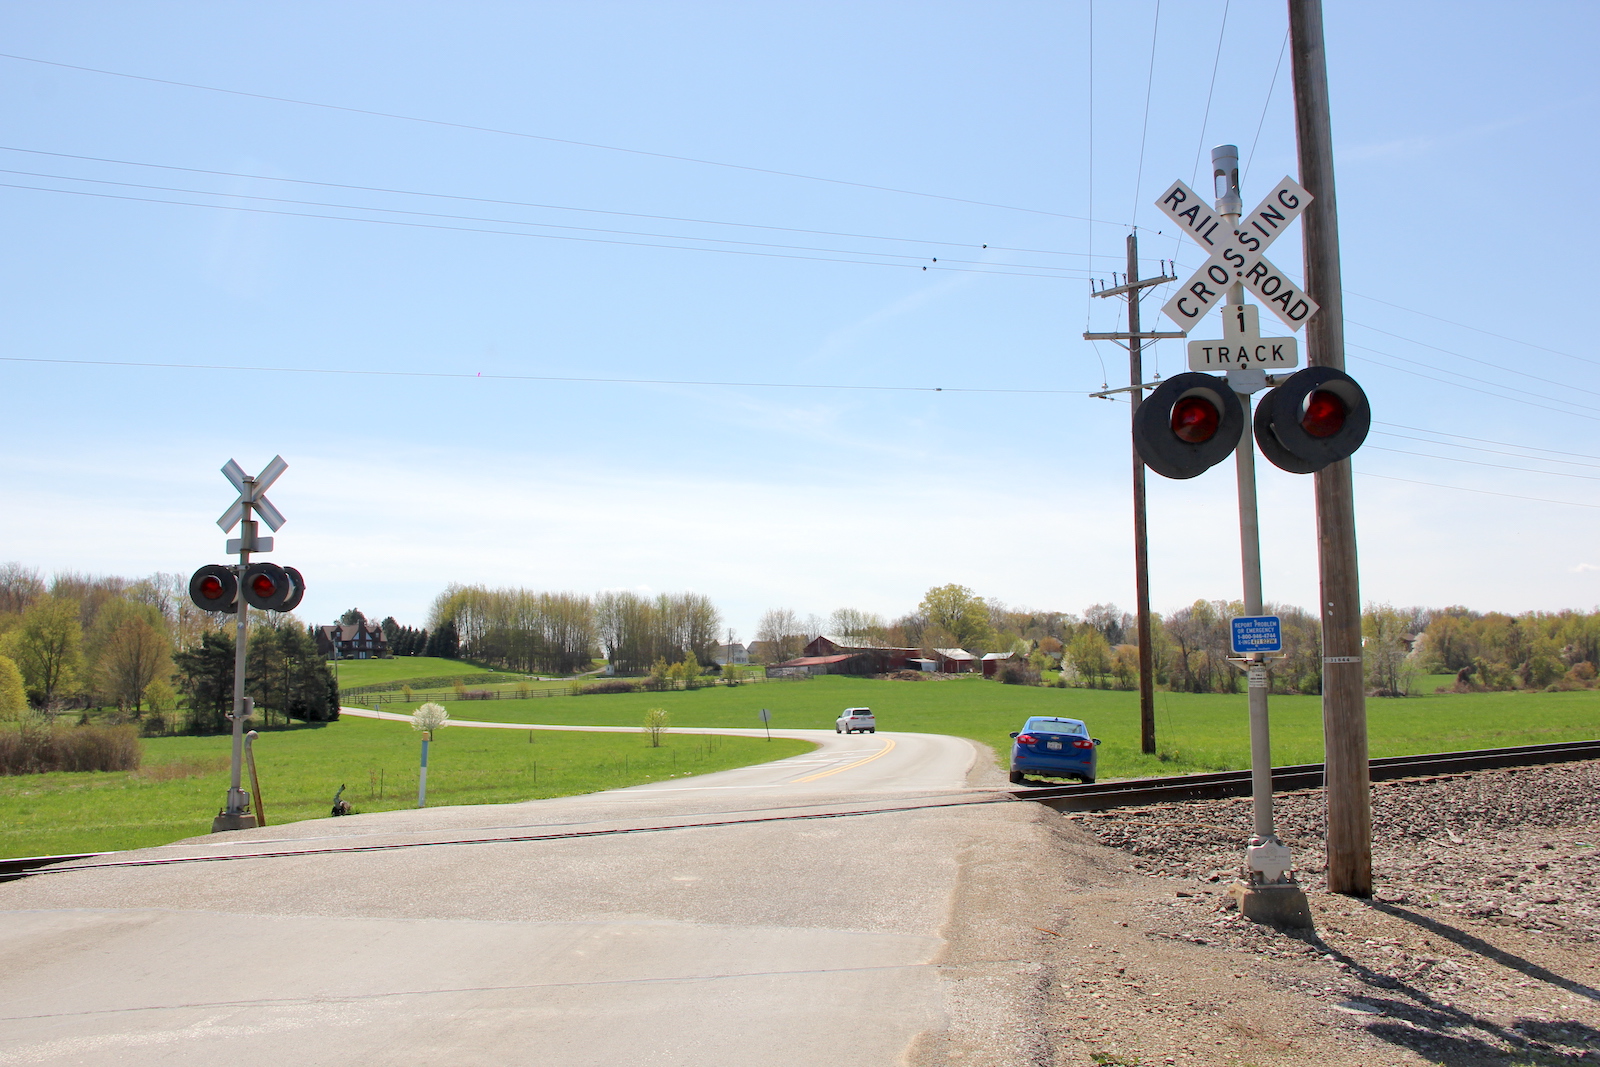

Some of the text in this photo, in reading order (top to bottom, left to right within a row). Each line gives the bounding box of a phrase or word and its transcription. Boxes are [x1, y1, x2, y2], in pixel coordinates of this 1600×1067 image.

[1163, 187, 1309, 321] RAIL ROAD
[1177, 189, 1299, 318] CROSSING
[1202, 344, 1284, 363] TRACK
[1236, 312, 1245, 332] 1
